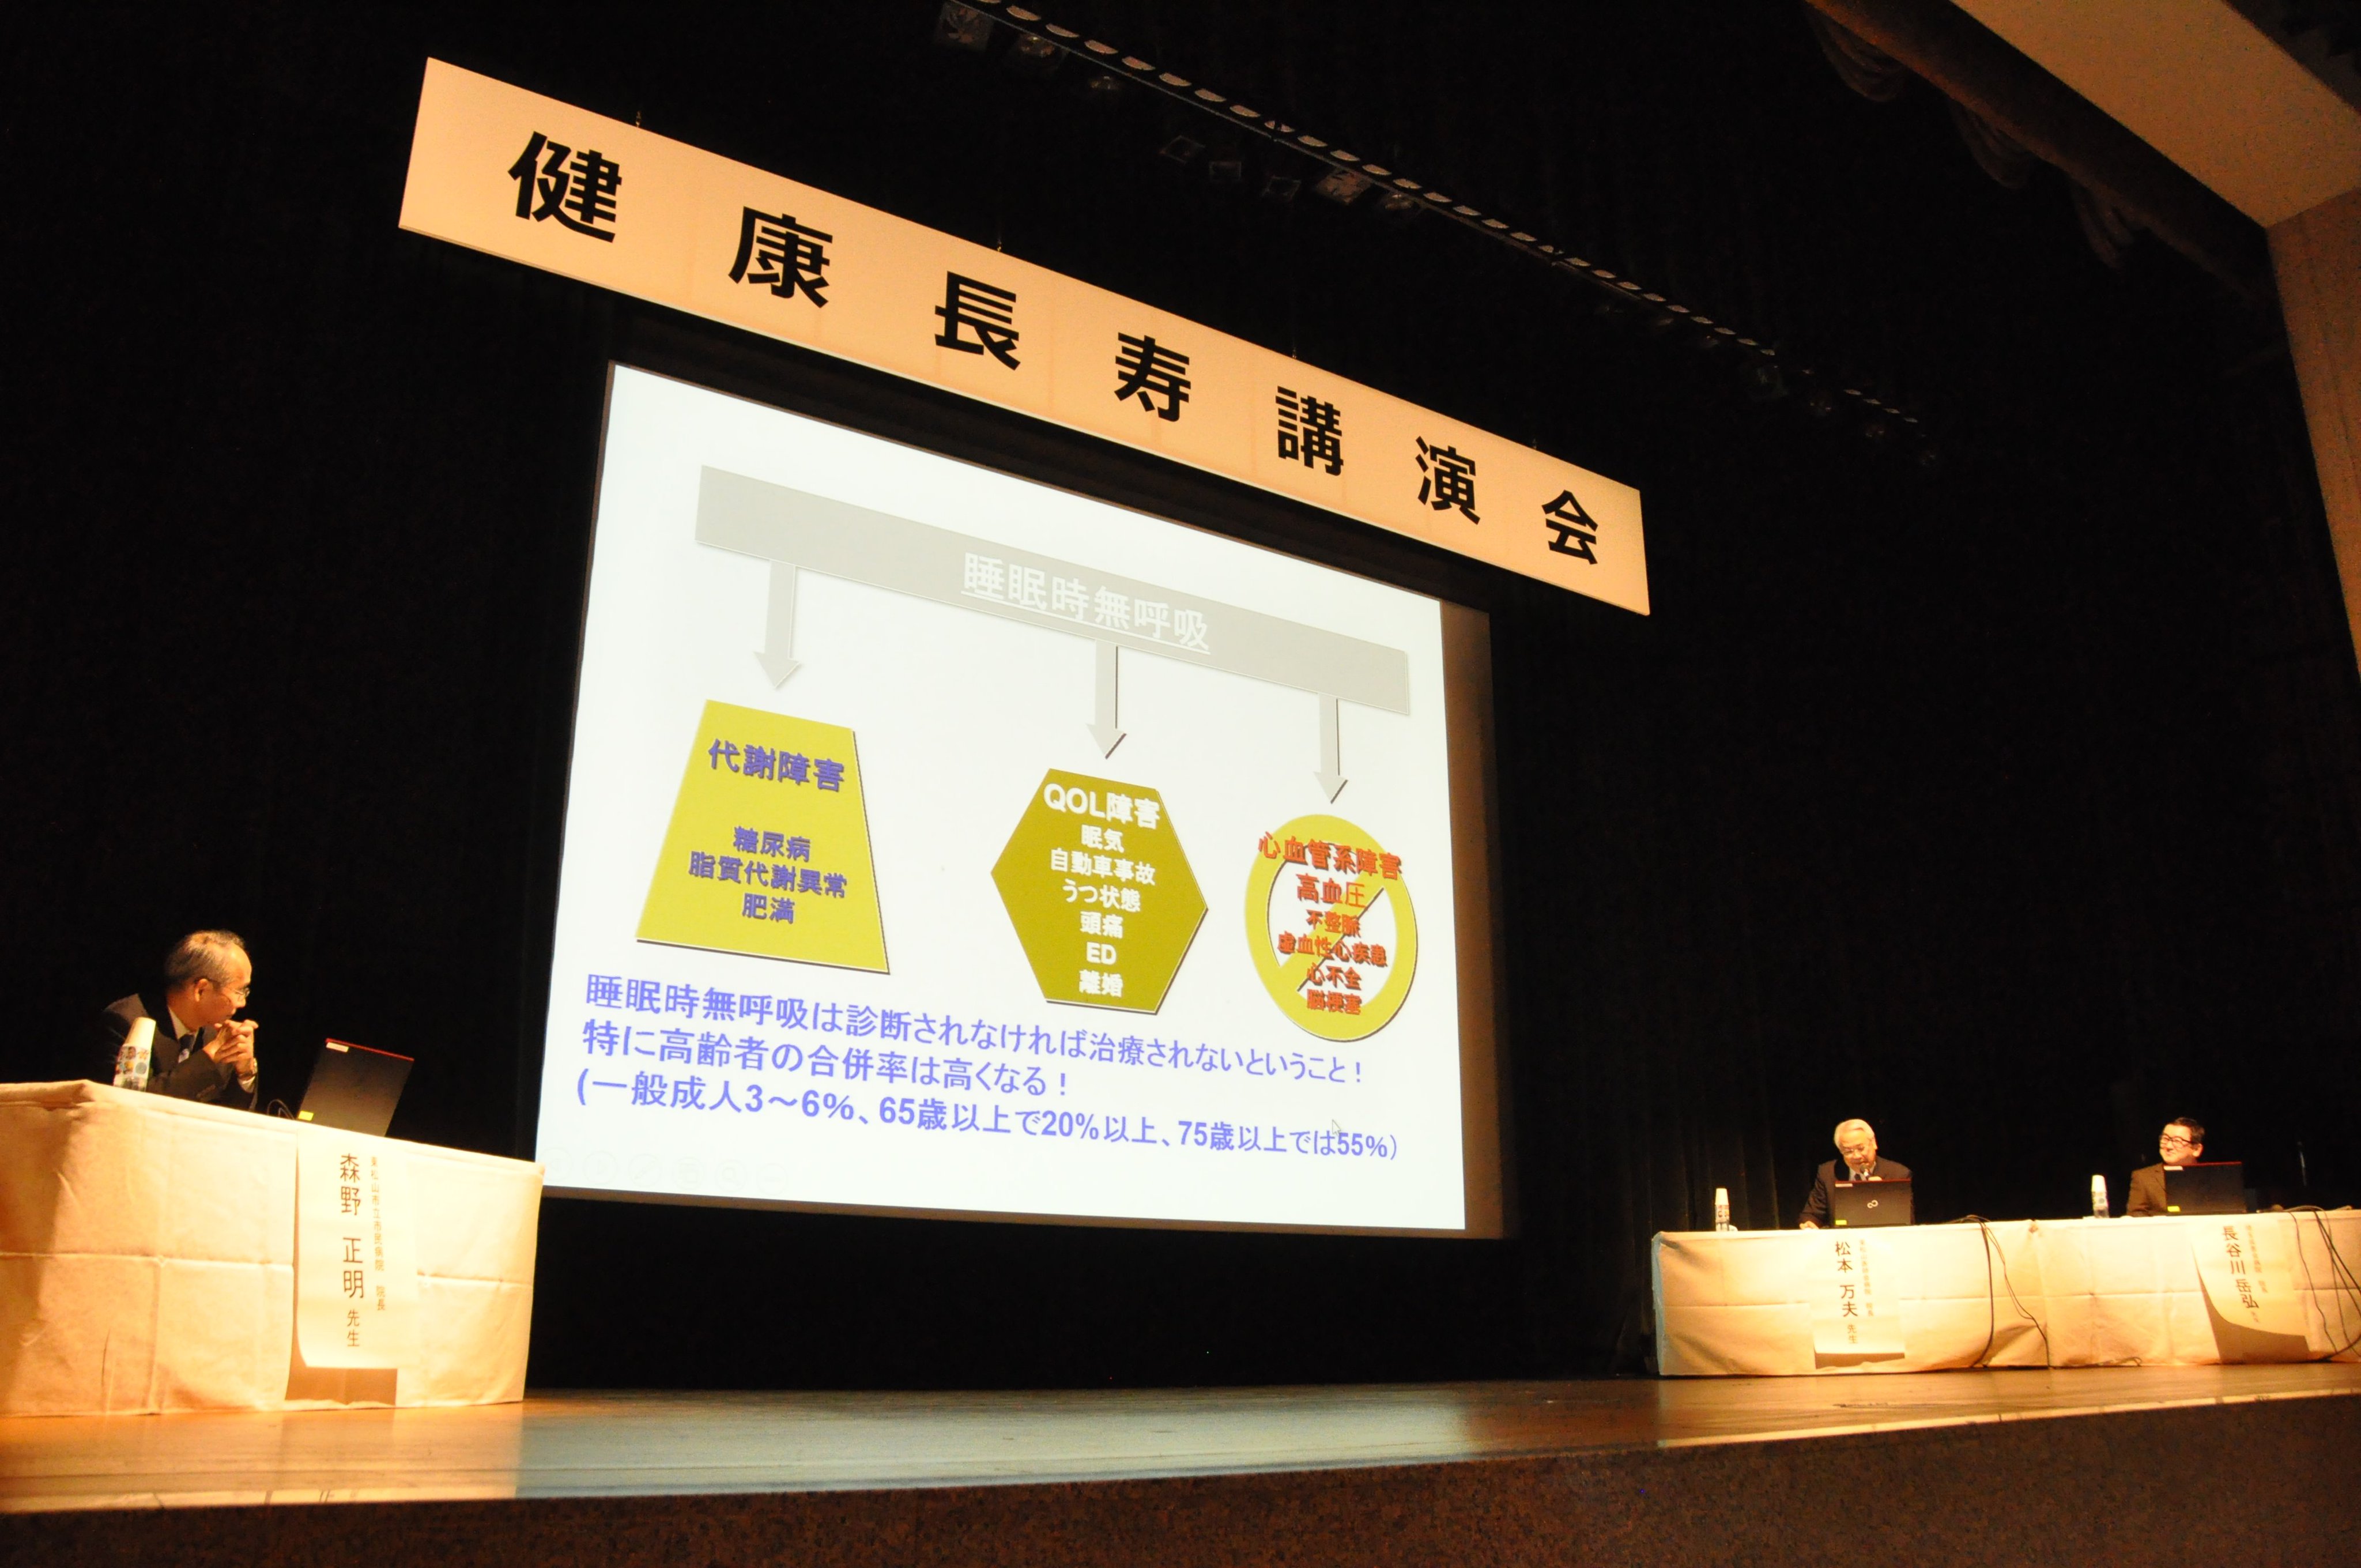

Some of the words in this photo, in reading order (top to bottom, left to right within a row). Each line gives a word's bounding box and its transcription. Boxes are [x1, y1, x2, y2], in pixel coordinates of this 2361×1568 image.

[507, 131, 1600, 566] 健康長寿講演会
[962, 552, 1210, 653] 睡眠時無呼吸
[708, 738, 845, 792] 代謝障害
[1043, 783, 1160, 830] QOL障害
[733, 826, 811, 862] 糖尿病
[1081, 824, 1125, 853] 眠気
[1258, 831, 1402, 881] 心血管系障害
[688, 850, 847, 898] 脂質代謝異常
[1050, 847, 1156, 886] 自動車事故
[742, 892, 795, 924] 肥満
[1062, 878, 1141, 913] うつ状態
[1295, 872, 1367, 909] 高血圧
[1080, 911, 1123, 939] 頭痛
[1306, 909, 1361, 938] 不整脈
[1086, 942, 1117, 965] ED
[1277, 930, 1388, 968] 虚血性心疾患
[1078, 969, 1123, 998] 離婚
[1306, 962, 1363, 991] 心不全
[1306, 989, 1363, 1016] 脳梗塞
[582, 1018, 1068, 1096] 特に高齢者の合併率は高くなる！
[340, 1153, 361, 1216] 森野
[343, 1237, 364, 1299] 正明
[1835, 1241, 1853, 1273] 松本
[347, 1309, 360, 1347] 先生
